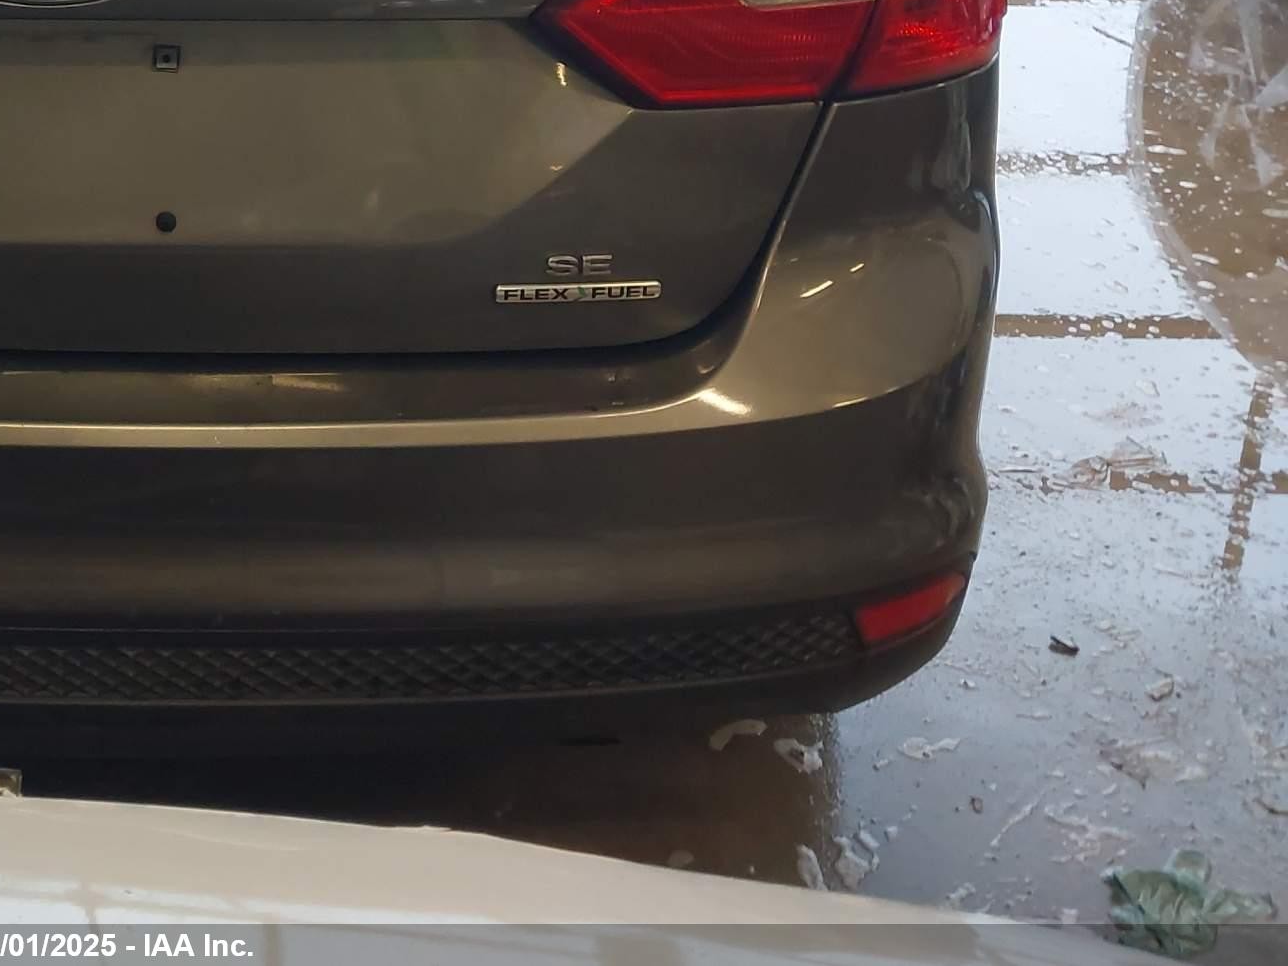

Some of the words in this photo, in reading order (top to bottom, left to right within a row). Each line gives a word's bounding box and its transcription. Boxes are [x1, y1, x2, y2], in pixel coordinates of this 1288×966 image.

[546, 253, 613, 276] SE
[502, 288, 569, 301] FLEX
[591, 285, 656, 299] FUEL
